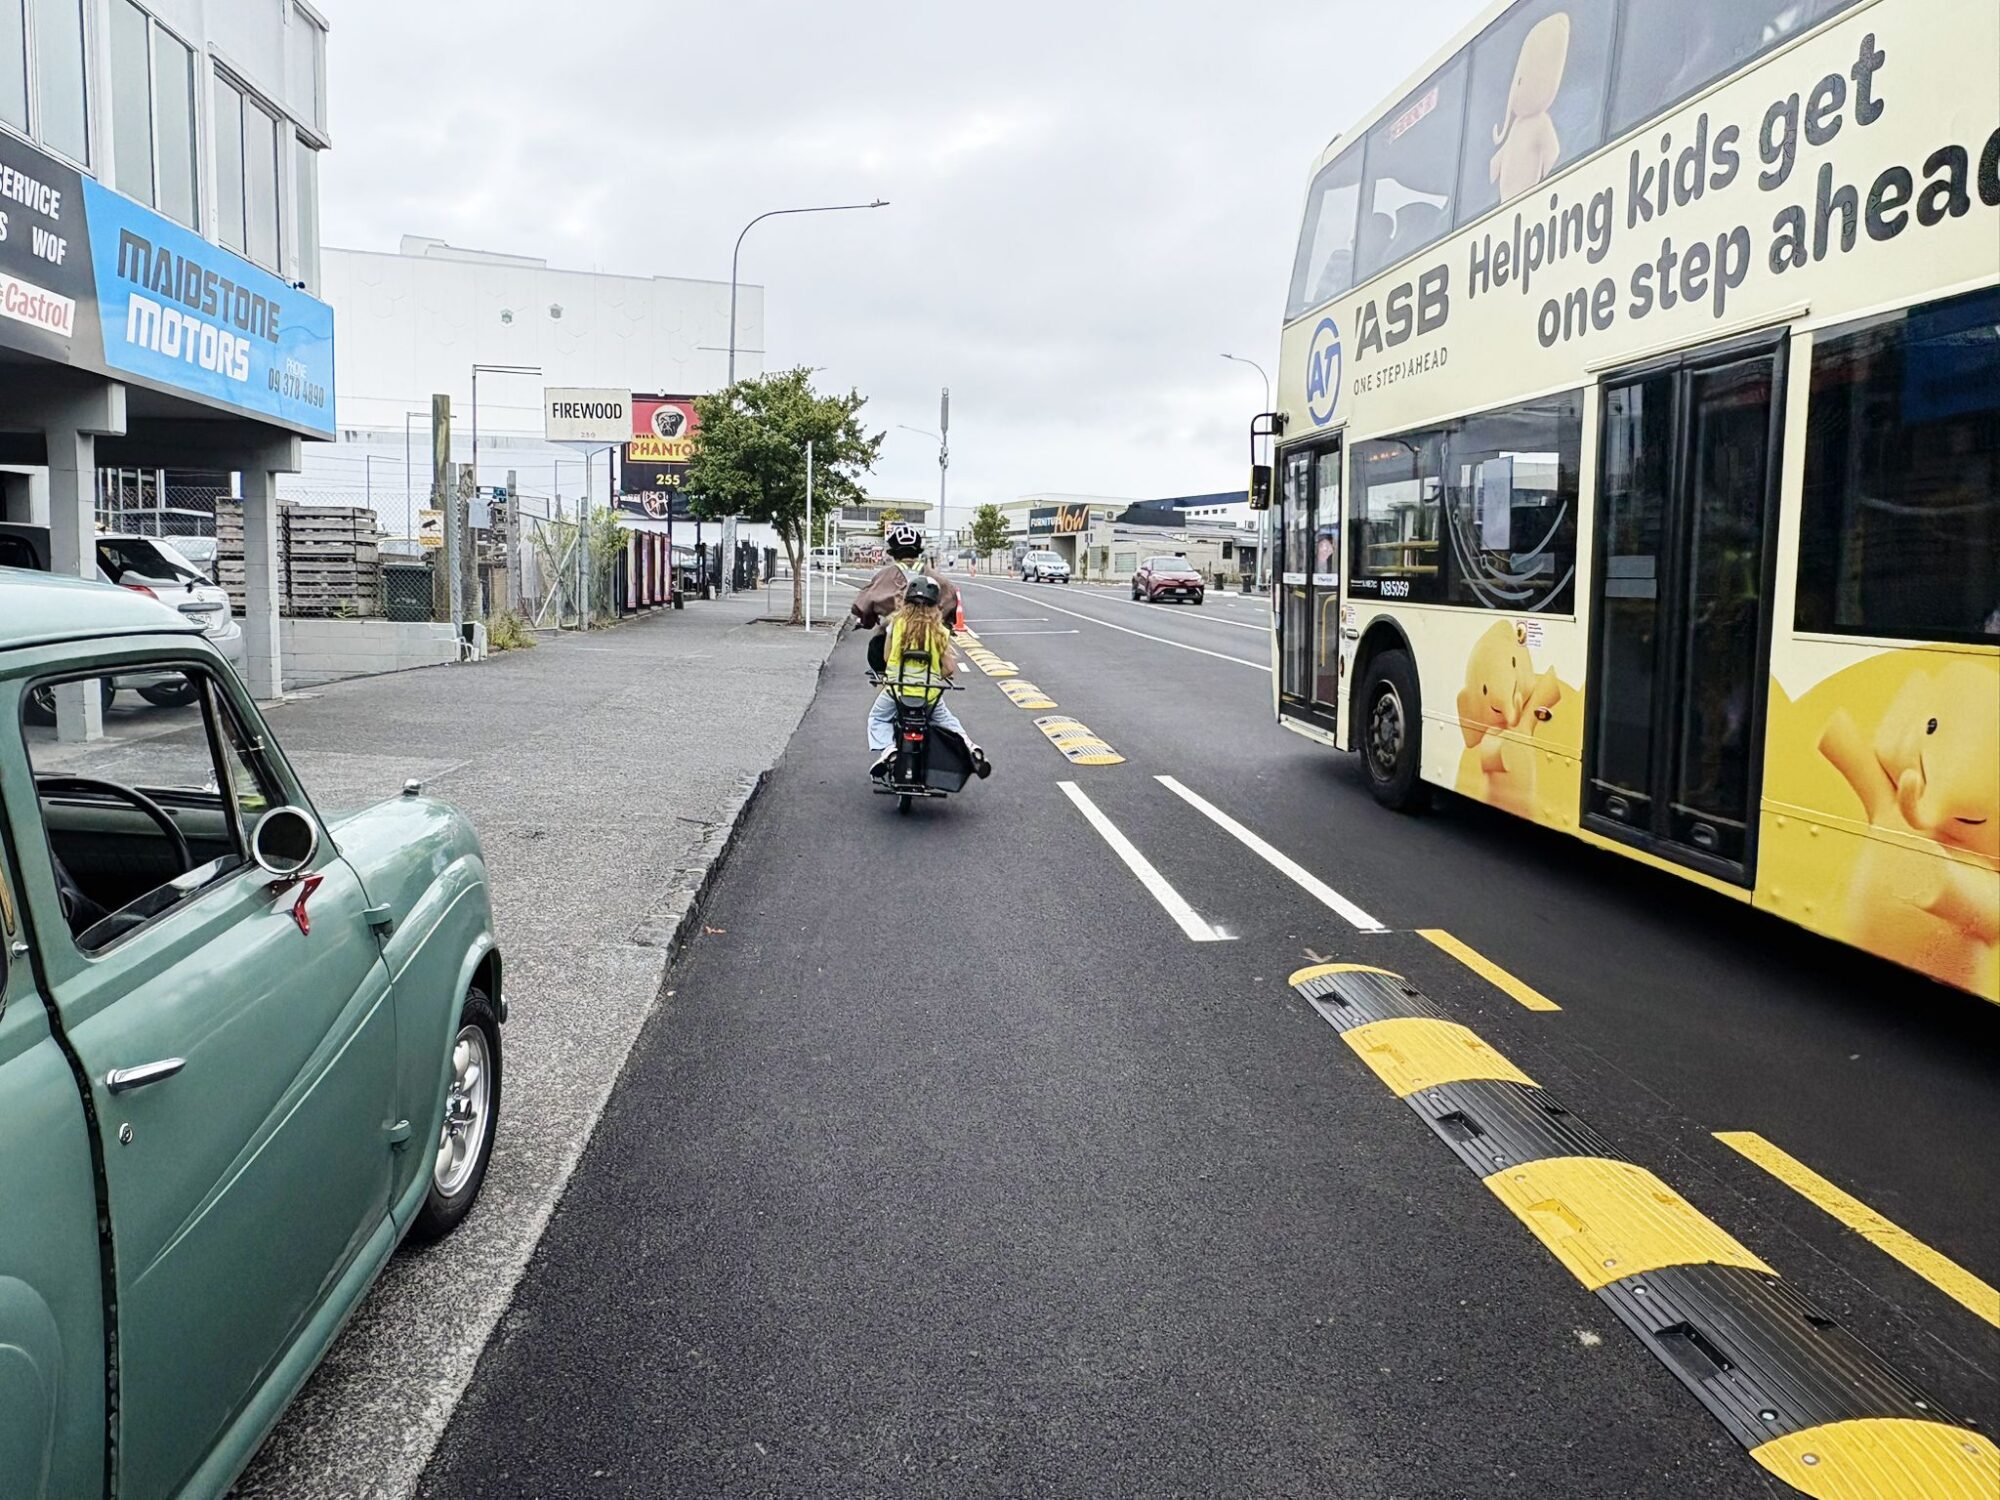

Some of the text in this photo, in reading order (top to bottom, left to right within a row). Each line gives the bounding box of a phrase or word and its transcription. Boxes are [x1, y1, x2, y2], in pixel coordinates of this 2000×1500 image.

[0, 162, 61, 221] ERVICE
[1468, 32, 1885, 299] Helping kids get
[32, 225, 67, 266] WOF
[5, 282, 69, 331] Castrol
[117, 227, 281, 344] MAIDSTONE
[1355, 263, 1450, 362] ASB
[1538, 277, 1616, 348] one
[1629, 225, 1751, 319] step
[126, 292, 251, 383] MOTORS
[268, 367, 324, 409] 09 378 4890
[1307, 341, 1341, 402] AT
[1353, 374, 1373, 396] ONE
[552, 402, 622, 419] FIREWOOD
[631, 442, 701, 456] PHANTO
[656, 474, 680, 485] 255
